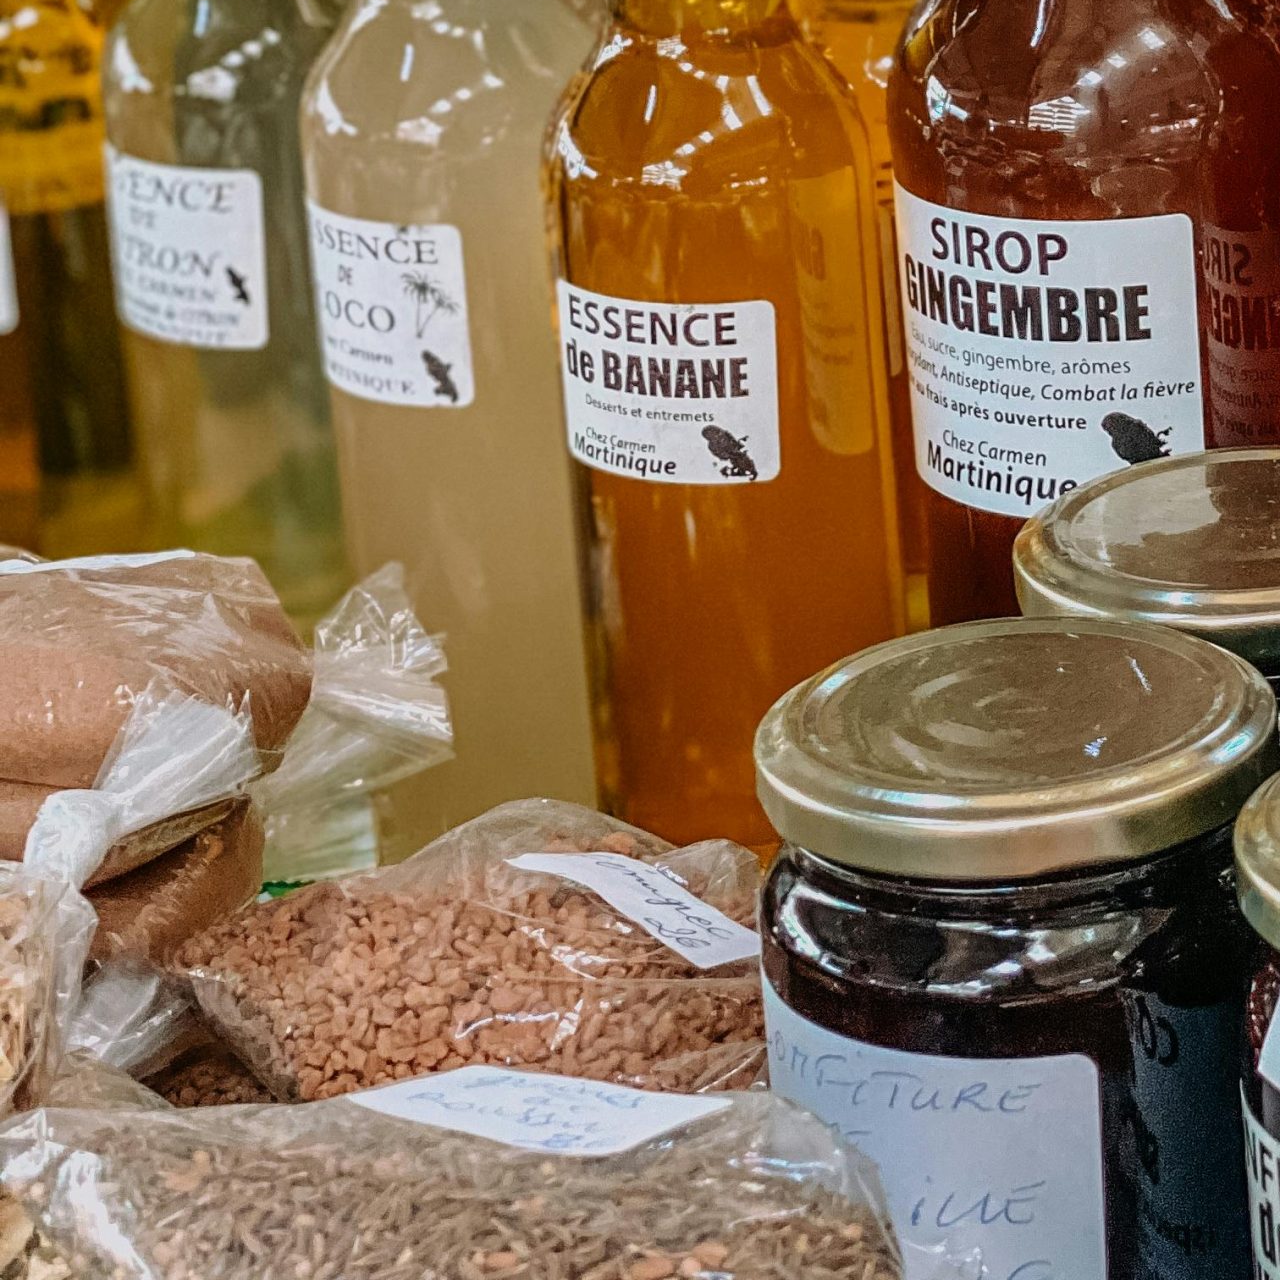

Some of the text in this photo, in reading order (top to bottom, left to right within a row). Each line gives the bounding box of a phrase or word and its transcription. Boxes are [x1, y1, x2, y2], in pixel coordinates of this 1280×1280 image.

[931, 216, 1068, 276] SIROP
[569, 293, 737, 347] ESSENCE
[905, 252, 1152, 343] GINGEMBRE
[566, 338, 749, 399] de BANANE
[928, 337, 960, 360] sucre,
[962, 347, 1056, 376] gingembre,
[1061, 357, 1132, 375] arômes
[926, 383, 949, 408] frais
[951, 399, 990, 421] après
[994, 410, 1087, 430] ouverture
[940, 365, 1036, 401] Antiseptique,
[1041, 383, 1117, 402] Combat
[1121, 383, 1138, 400] la
[1143, 380, 1196, 399] fièvre
[585, 393, 715, 422] Desserts et entremets
[574, 432, 677, 477] Martinique
[585, 426, 656, 454] Chez Carmen
[943, 429, 1047, 467] Chez Carmen
[927, 439, 1078, 506] Martinique
